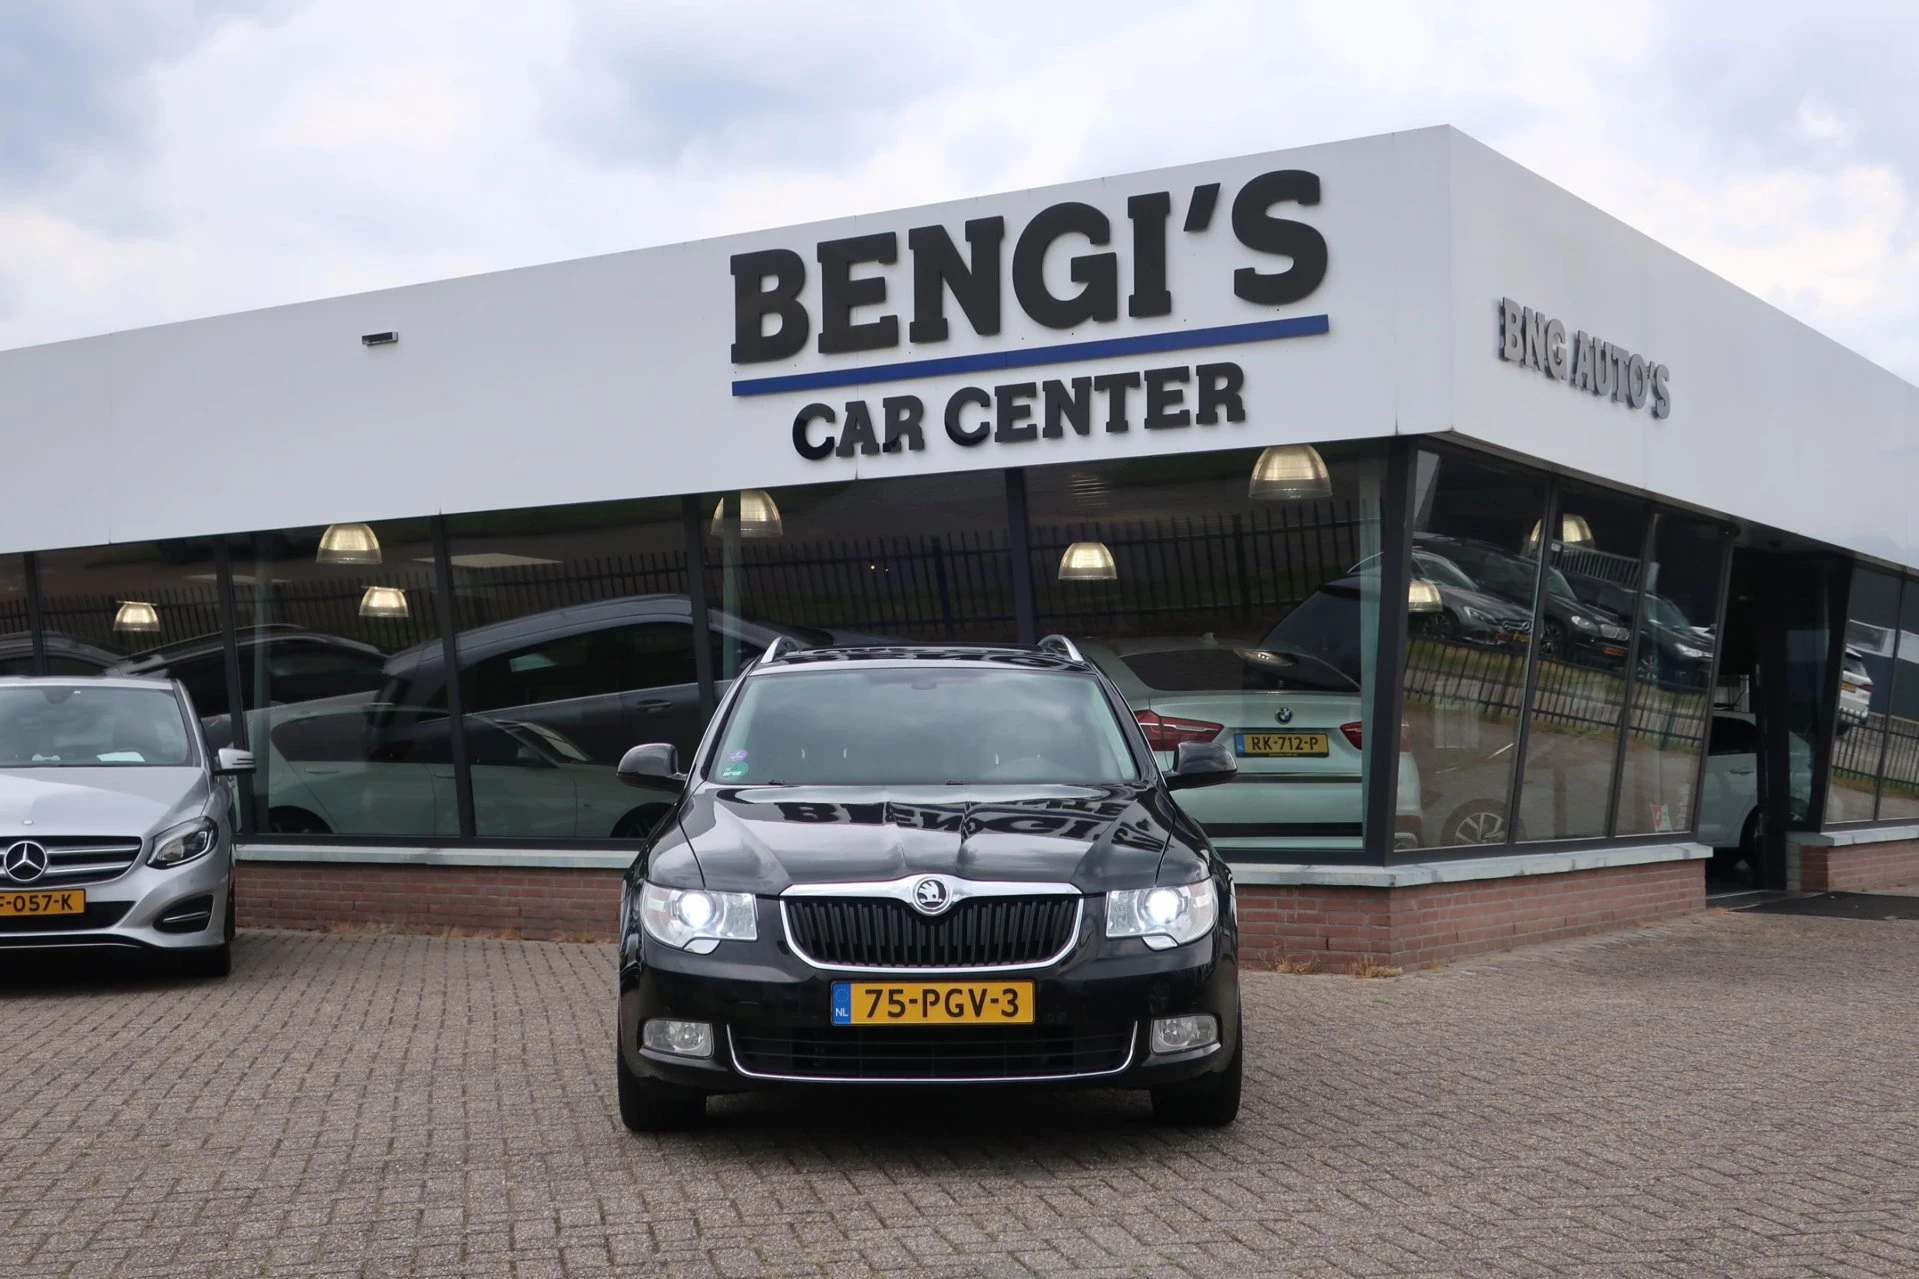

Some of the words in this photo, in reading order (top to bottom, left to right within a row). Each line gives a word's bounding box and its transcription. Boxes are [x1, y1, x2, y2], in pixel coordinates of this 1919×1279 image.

[730, 169, 1328, 364] BENGI'S
[1500, 296, 1567, 381] BNG
[1572, 330, 1671, 419] AUTO'S
[792, 395, 925, 461] CAR
[943, 361, 1246, 447] CENTER
[1251, 736, 1319, 751] RK-712-P
[835, 1008, 848, 1017] NL
[864, 988, 1019, 1018] 75-PGV-3
